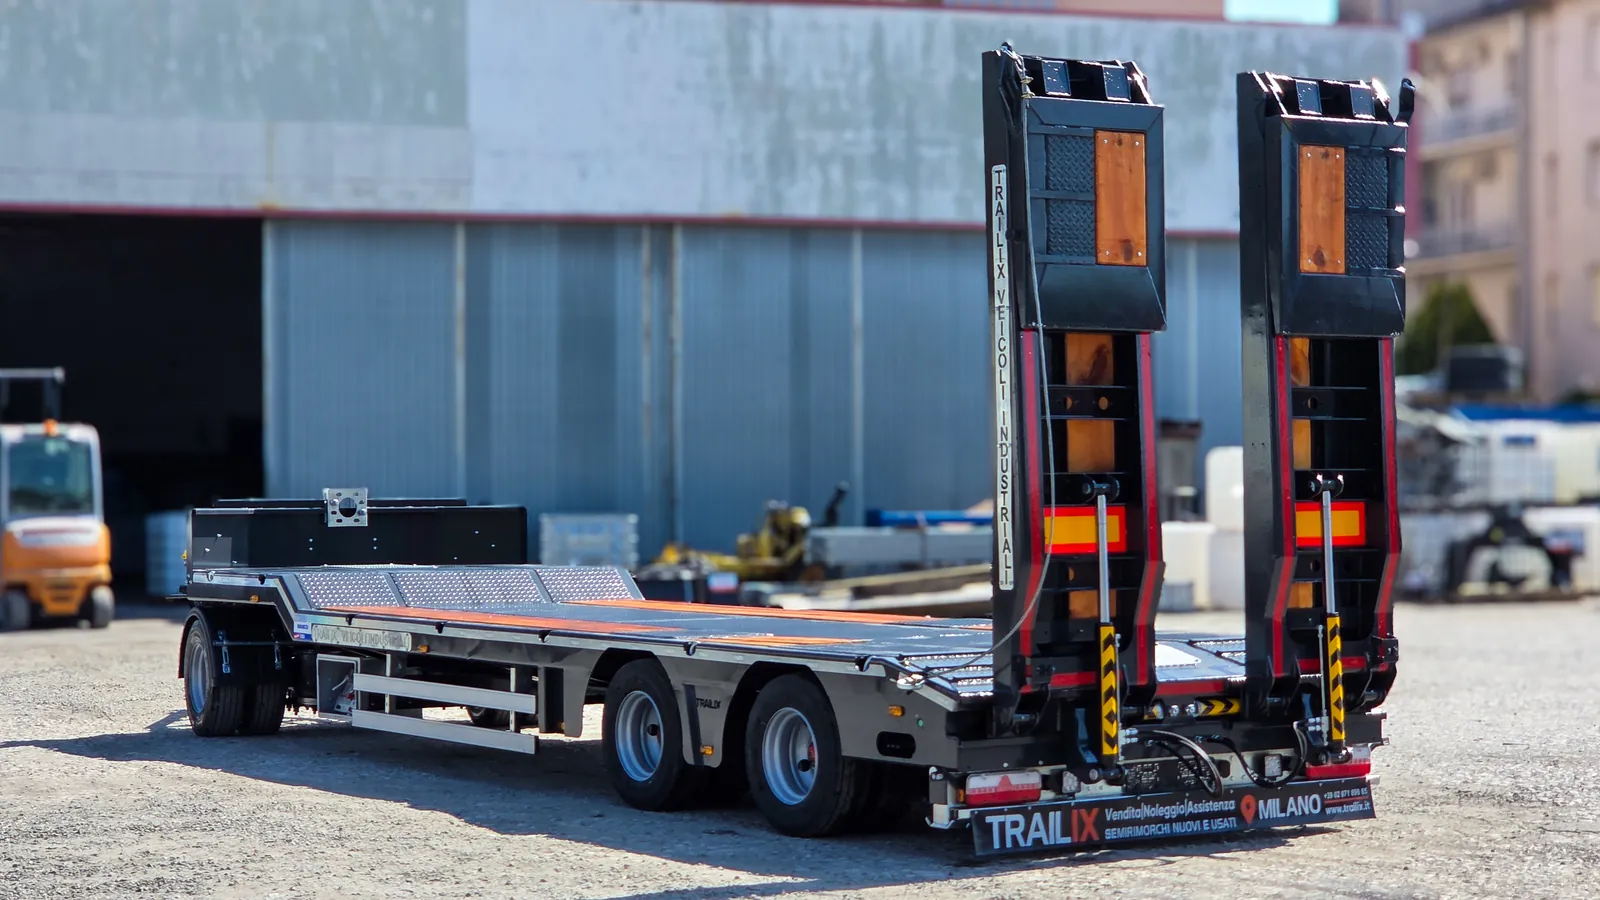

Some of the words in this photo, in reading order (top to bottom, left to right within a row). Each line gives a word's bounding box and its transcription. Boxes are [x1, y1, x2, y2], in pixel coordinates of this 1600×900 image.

[995, 169, 1005, 279] TRAILIX
[997, 289, 1008, 400] VEICOLI
[999, 411, 1012, 585] INDUSTRIALI
[695, 697, 721, 709] TRAILIX
[1258, 793, 1321, 820] MILANO
[1324, 800, 1371, 815] www.trailix.it
[985, 808, 1099, 849] TRAILIX
[1104, 823, 1170, 840] SEMIRIMORCHI
[1172, 820, 1200, 833] NUOVI
[1202, 819, 1210, 830] E
[1211, 817, 1237, 829] USATI
